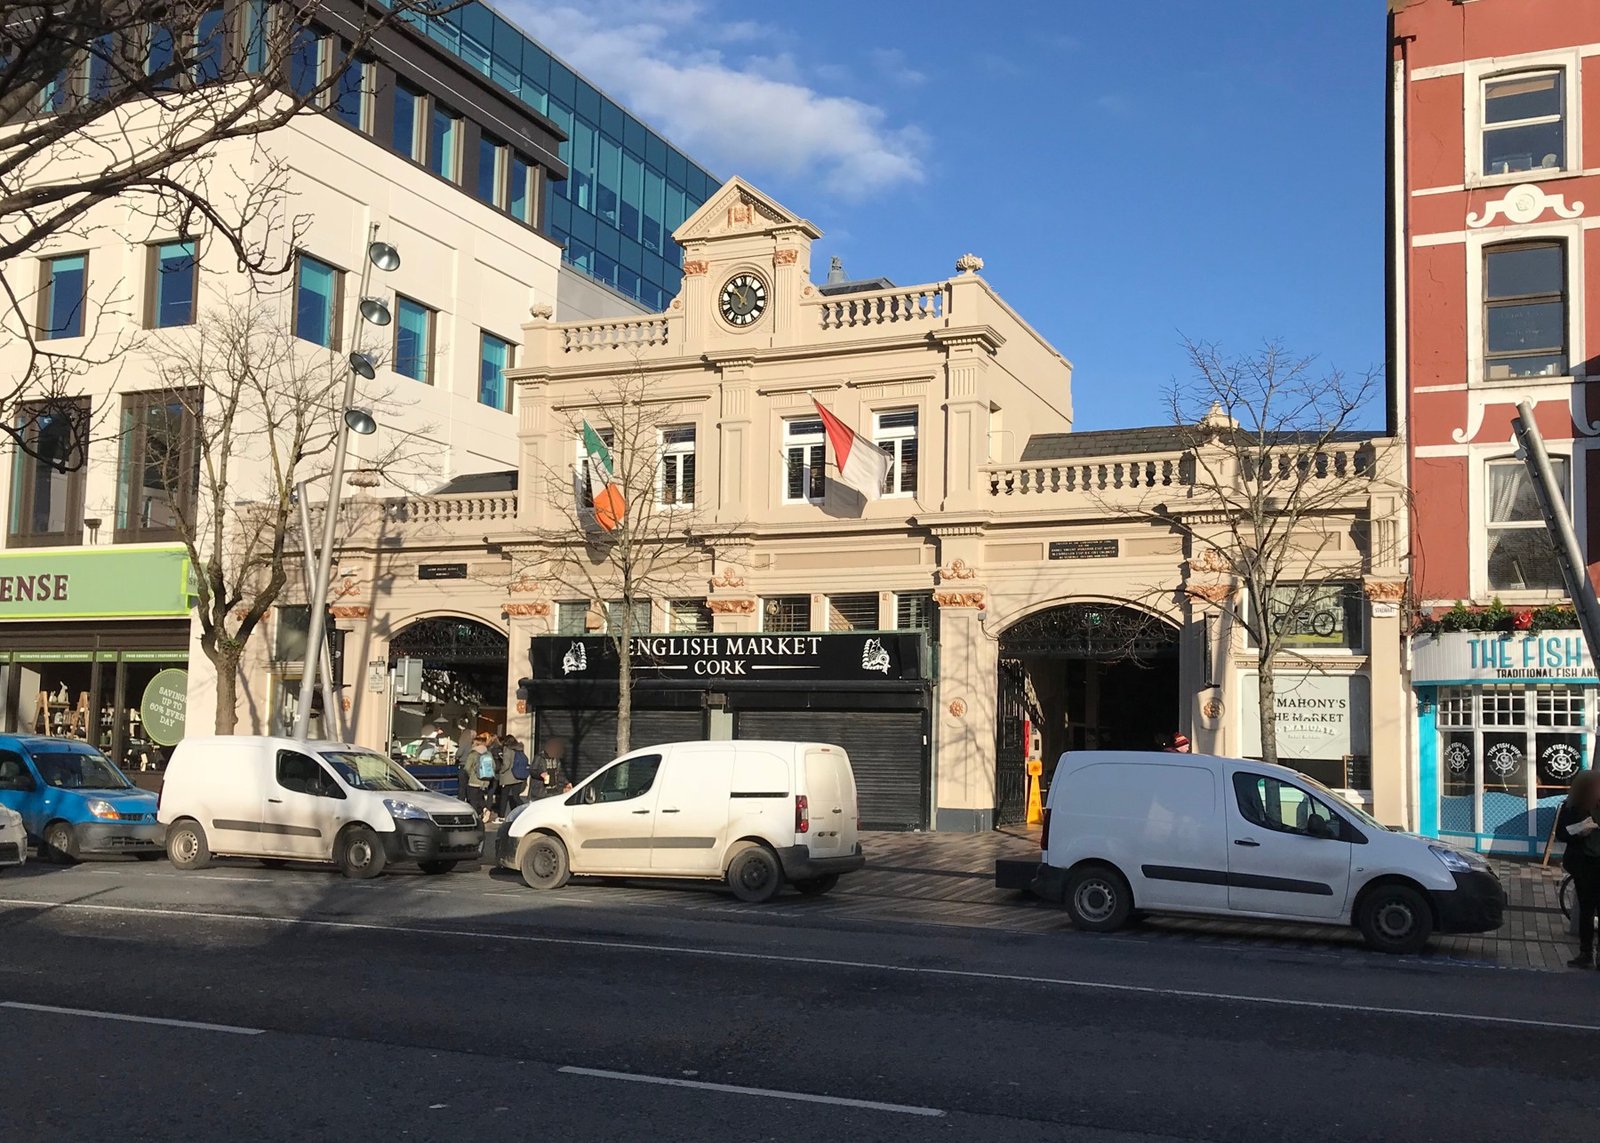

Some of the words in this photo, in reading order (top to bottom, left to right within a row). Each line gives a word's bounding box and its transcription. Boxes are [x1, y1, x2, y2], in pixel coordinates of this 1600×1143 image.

[0, 573, 69, 602] ENSE
[628, 637, 719, 656] ENGLISH
[725, 636, 822, 656] MARKET
[1467, 637, 1514, 669] THE
[1519, 636, 1582, 668] FISH
[694, 660, 747, 675] CORK
[1496, 668, 1554, 679] TRADITIONAL
[1556, 668, 1578, 678] FISH
[162, 697, 172, 706] UP
[173, 702, 183, 710] TO
[1274, 698, 1346, 709] 'MAHONY'S
[150, 702, 165, 714] 60%
[165, 709, 185, 721] EVER
[1274, 712, 1290, 721] HE
[160, 716, 176, 727] DAY
[1486, 745, 1498, 757] THE
[1496, 742, 1510, 750] FISH
[1542, 746, 1554, 758] THE
[1552, 743, 1568, 751] FISH
[1567, 745, 1582, 760] WIFE
